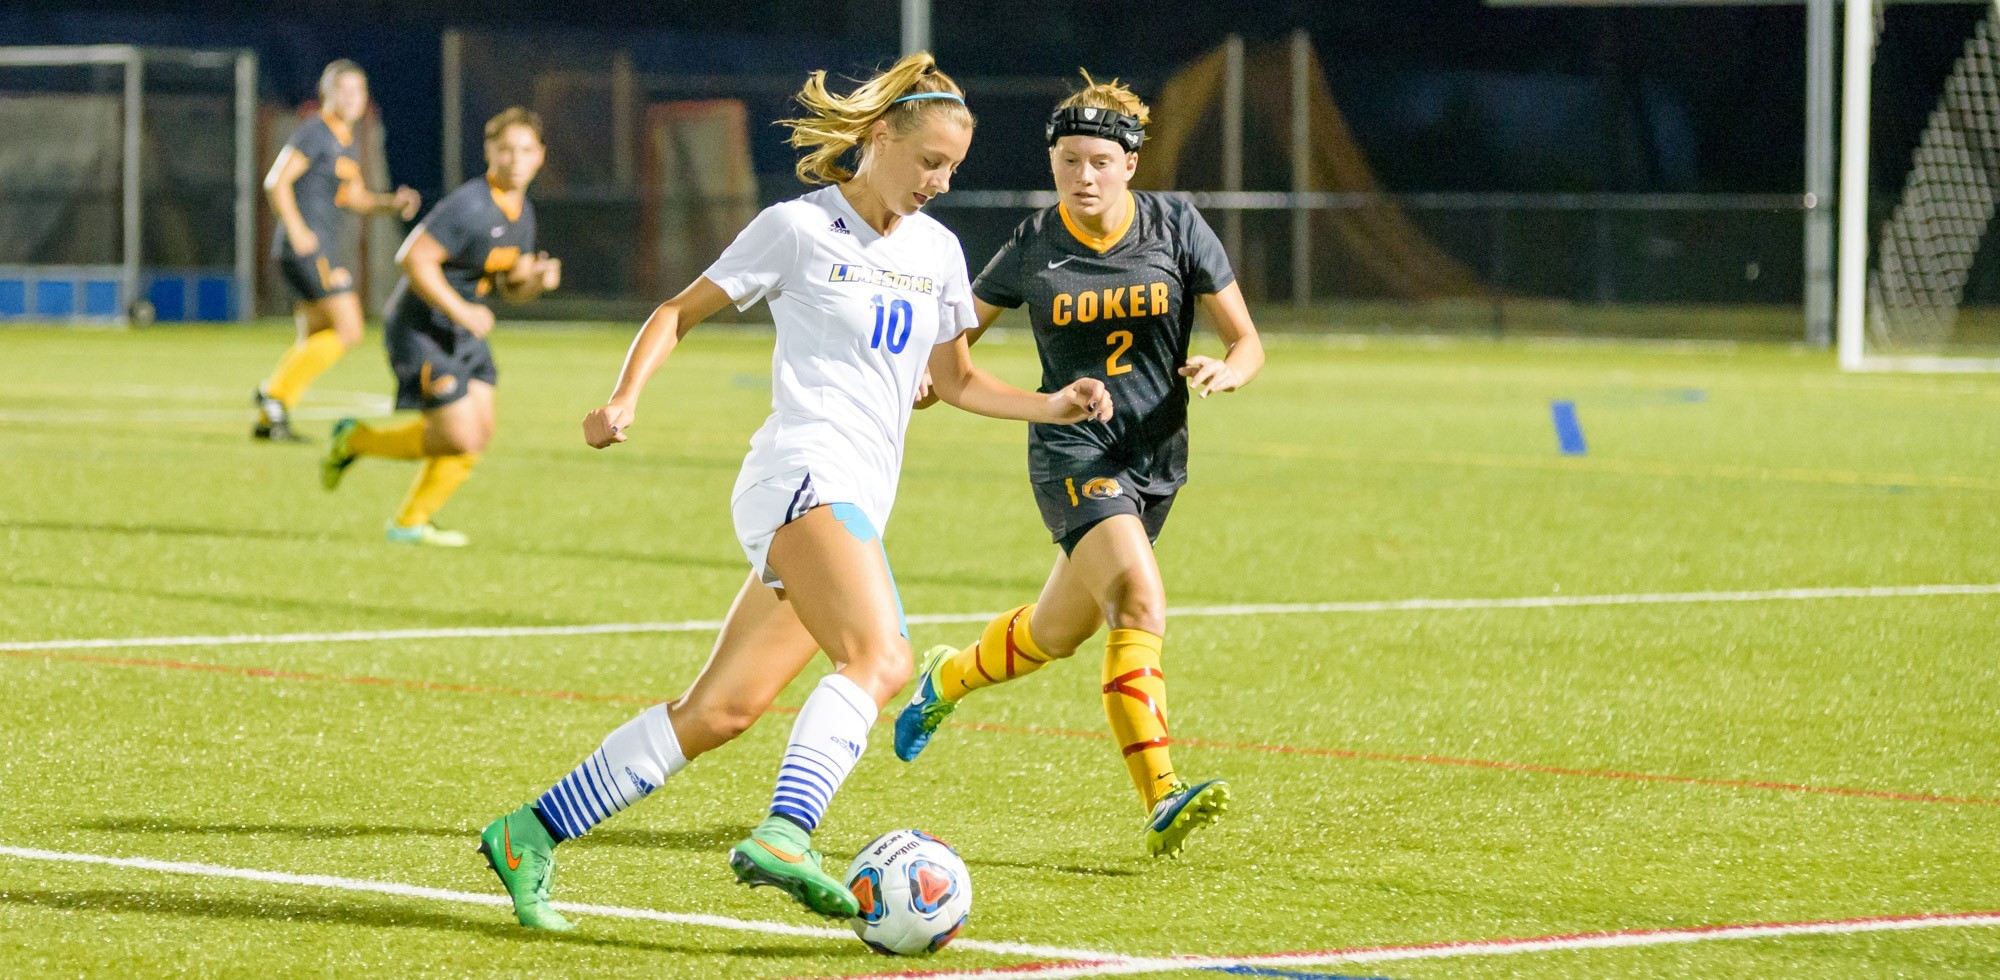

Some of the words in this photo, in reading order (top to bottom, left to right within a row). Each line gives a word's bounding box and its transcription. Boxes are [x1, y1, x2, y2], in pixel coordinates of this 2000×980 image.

[828, 227, 850, 235] adidas
[828, 263, 933, 295] LIMESTONE
[1052, 281, 1169, 326] COKER
[869, 294, 913, 355] 10
[1105, 329, 1134, 377] 2
[884, 841, 920, 866] Wilson
